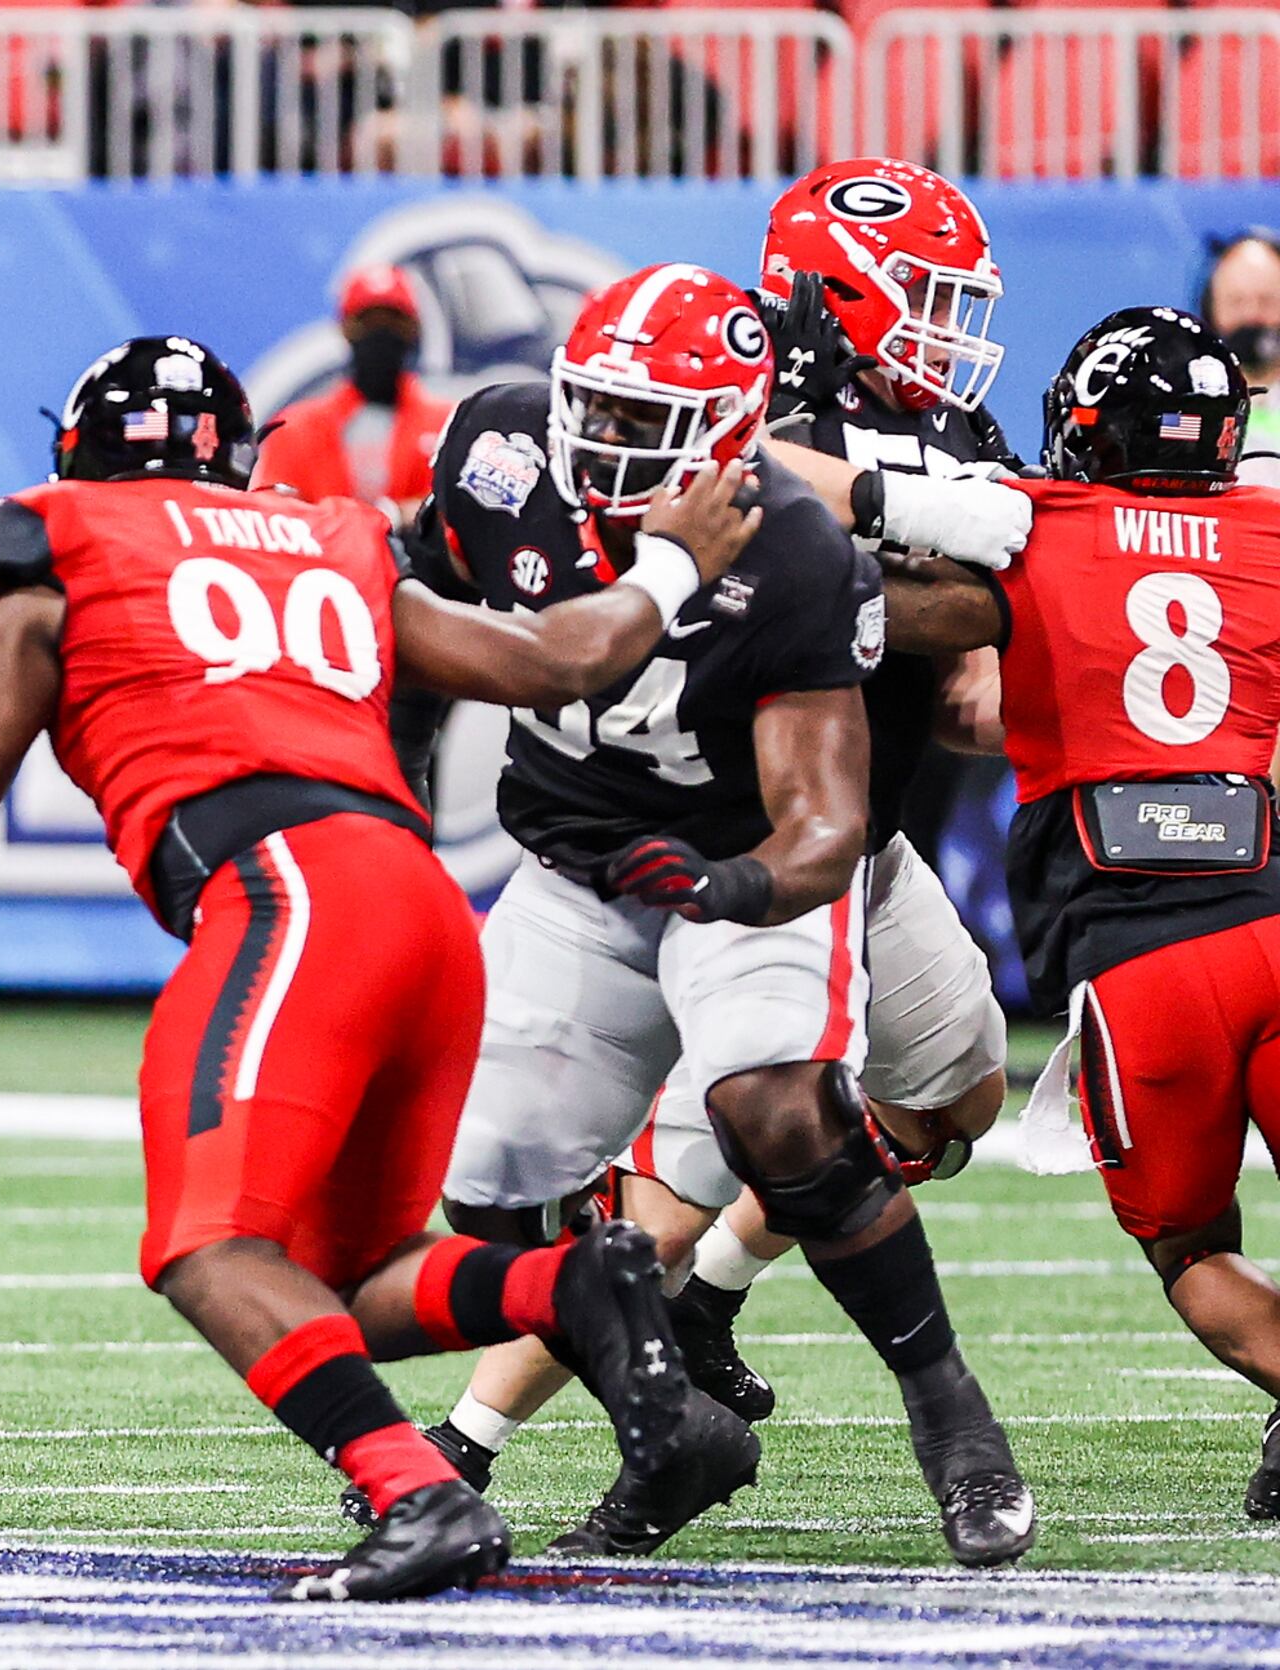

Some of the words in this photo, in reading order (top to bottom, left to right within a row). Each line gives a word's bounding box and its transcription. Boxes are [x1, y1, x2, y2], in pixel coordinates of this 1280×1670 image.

[193, 507, 324, 558] TAYLOR
[1113, 506, 1222, 562] WHITE
[167, 557, 382, 702] 90
[1123, 572, 1232, 746] 8
[1138, 803, 1191, 823] PRO
[1158, 822, 1226, 842] GEAR
